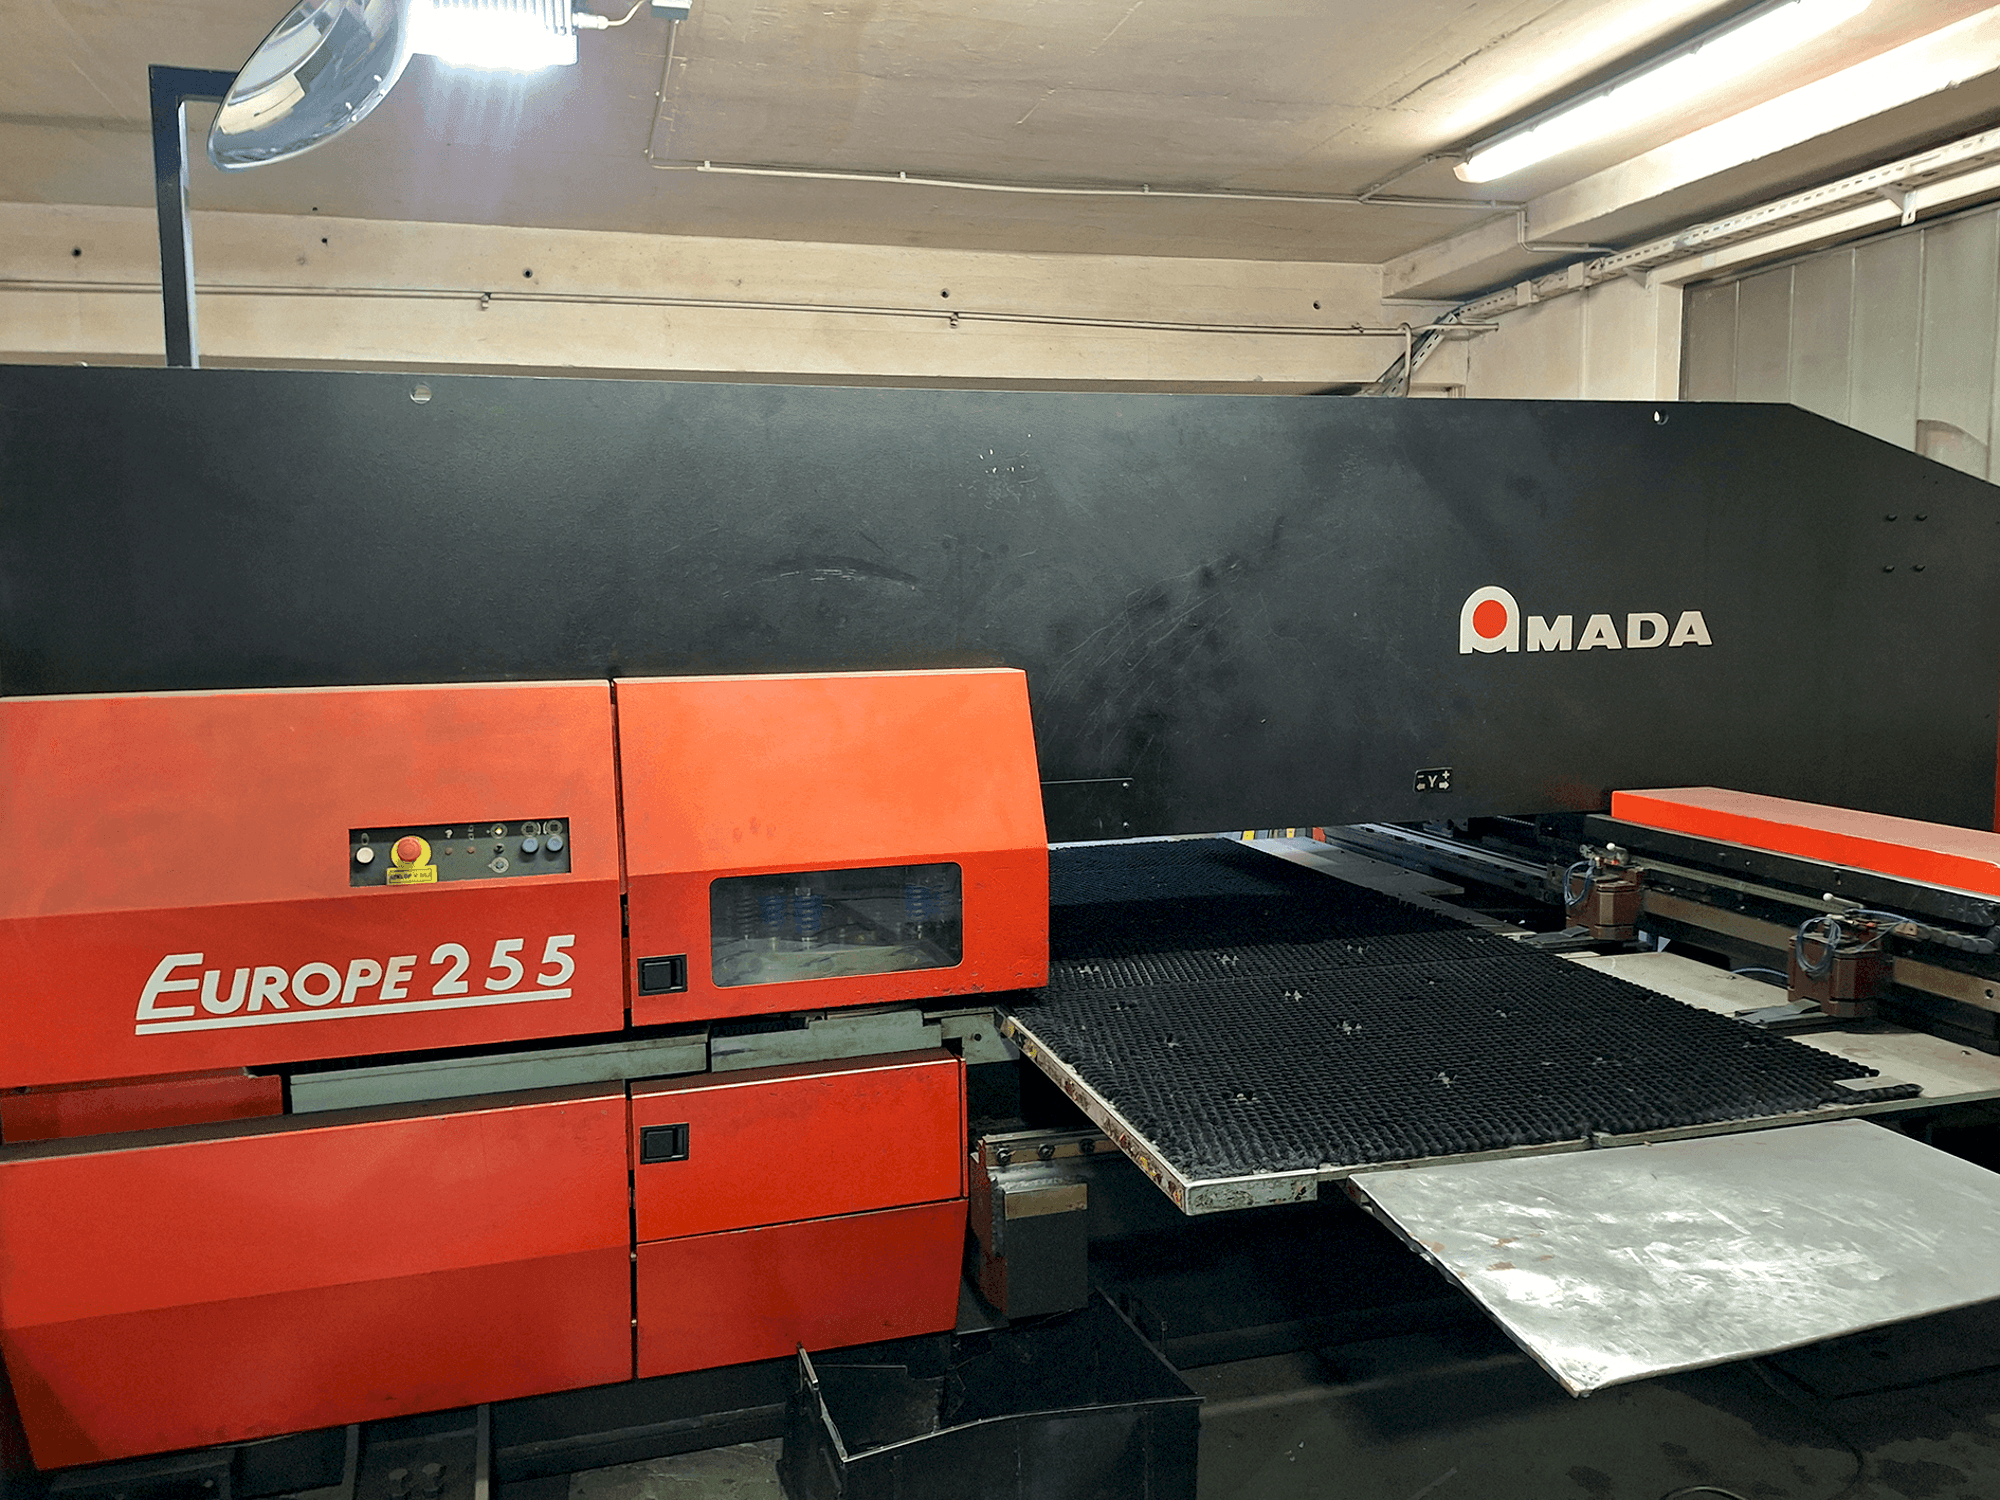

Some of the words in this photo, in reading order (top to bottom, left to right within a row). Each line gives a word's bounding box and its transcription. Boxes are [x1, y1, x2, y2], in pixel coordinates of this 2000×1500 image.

[1459, 585, 1713, 655] AMADA
[1427, 775, 1438, 788] Y
[135, 952, 418, 1021] EUROPE
